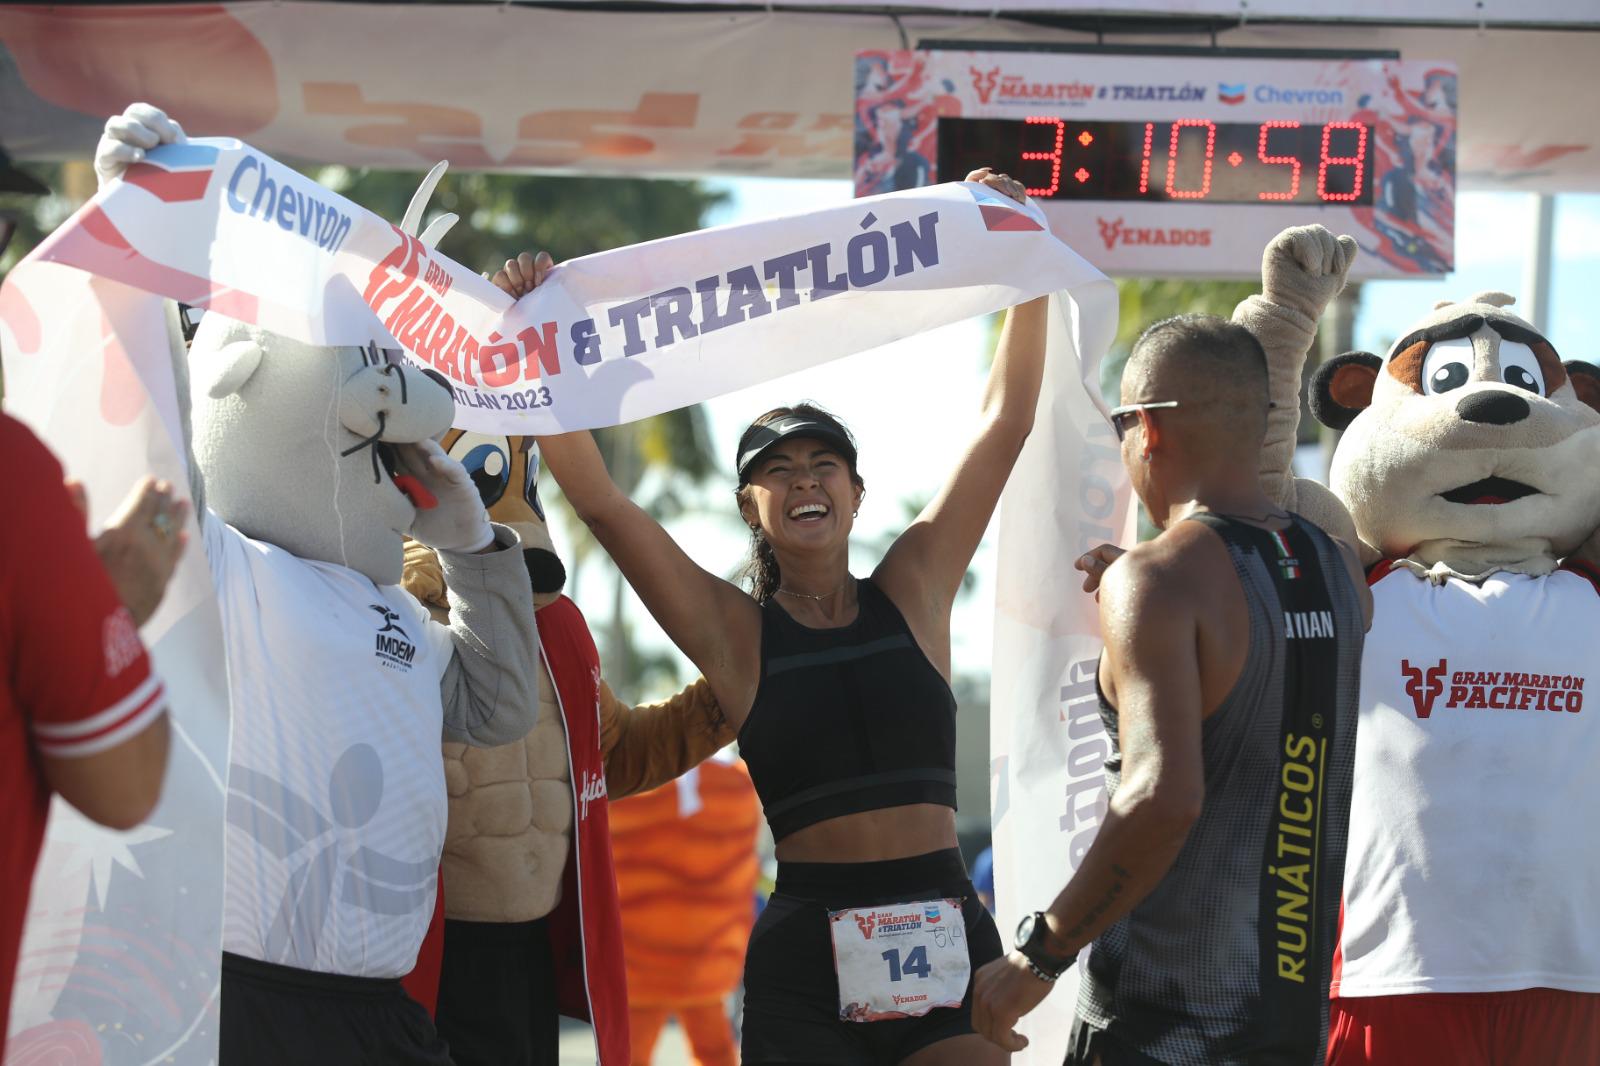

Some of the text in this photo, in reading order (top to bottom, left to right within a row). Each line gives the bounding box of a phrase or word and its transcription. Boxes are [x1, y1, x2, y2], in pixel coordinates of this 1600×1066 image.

[1111, 82, 1207, 101] TRIATLÓN
[1254, 85, 1344, 106] Chevron
[227, 154, 352, 256] Chevron
[1097, 217, 1212, 251] VENADOS
[424, 259, 453, 298] GRAN
[384, 211, 939, 388] MARATÓN & TRIATLÓN
[452, 386, 553, 411] ATLÁN 2023
[376, 633, 416, 663] IMDEM
[1452, 671, 1585, 691] GRAN MARATÓN
[1446, 685, 1584, 714] PACÍFICO
[1268, 732, 1317, 984] RUNÁTICOS
[881, 945, 931, 982] 14
